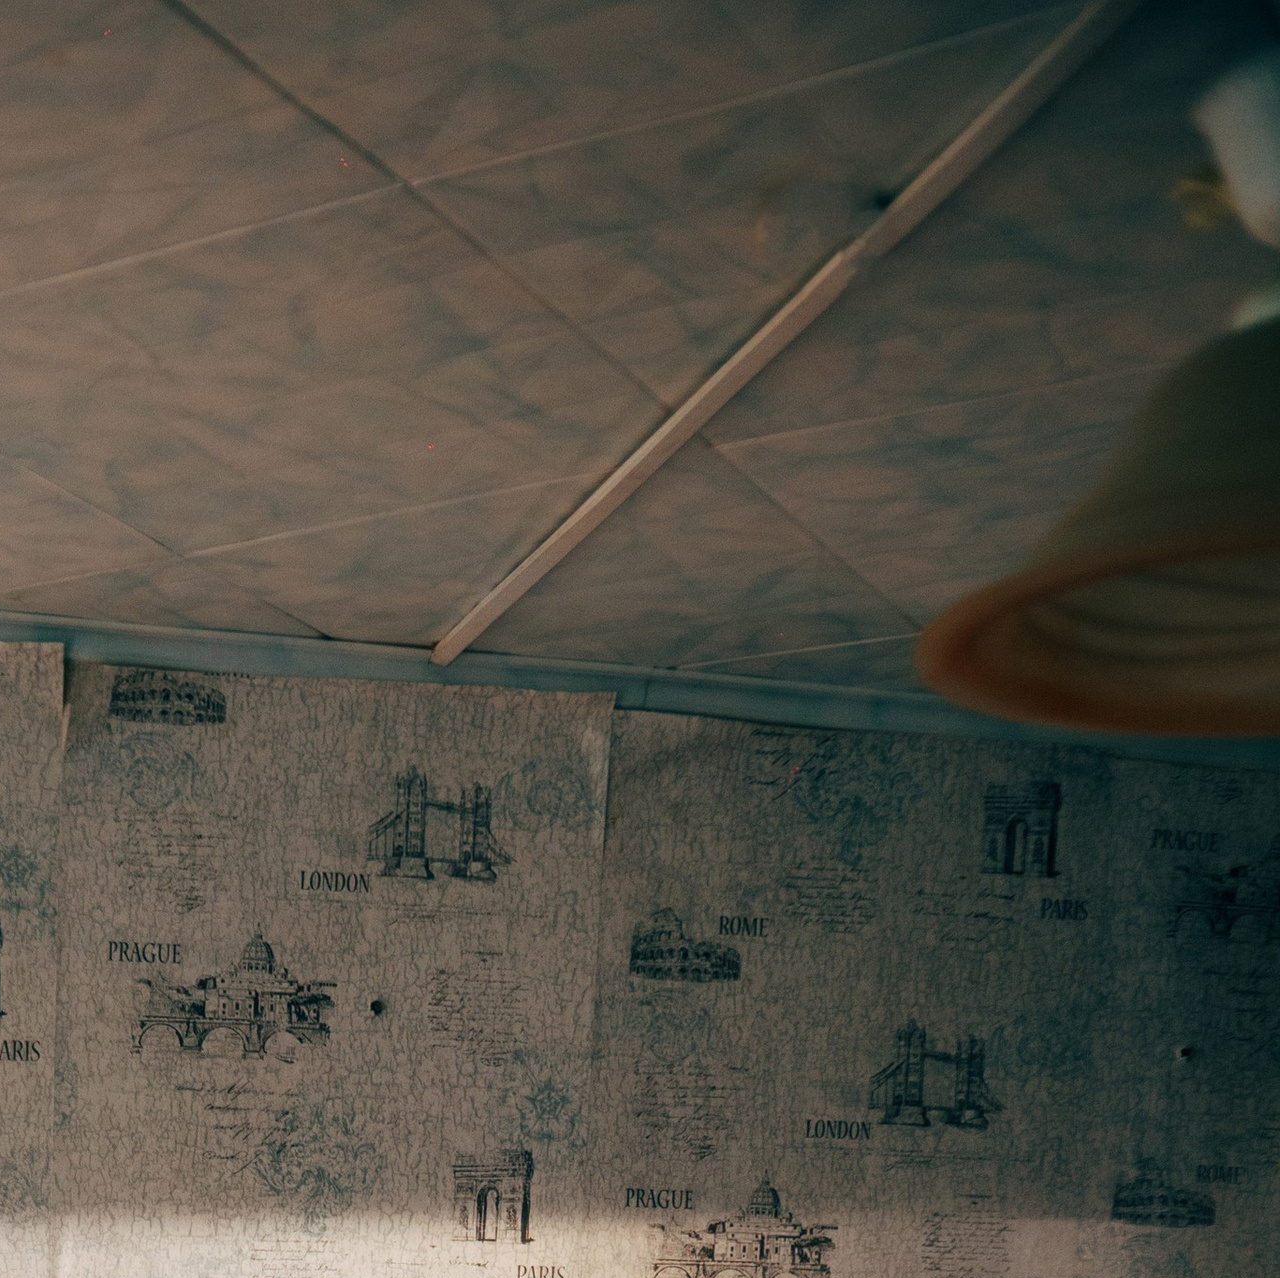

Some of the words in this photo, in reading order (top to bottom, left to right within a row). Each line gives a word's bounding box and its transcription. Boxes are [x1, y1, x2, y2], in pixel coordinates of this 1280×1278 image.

[1150, 828, 1220, 854] PRAGUE
[299, 869, 370, 894] LONDON
[1040, 897, 1089, 921] PARIS
[719, 915, 770, 938] ROME
[107, 940, 182, 965] PRAGUE
[804, 1118, 872, 1142] LONDON
[1196, 1163, 1243, 1186] ROME
[624, 1186, 694, 1211] PRAGUE
